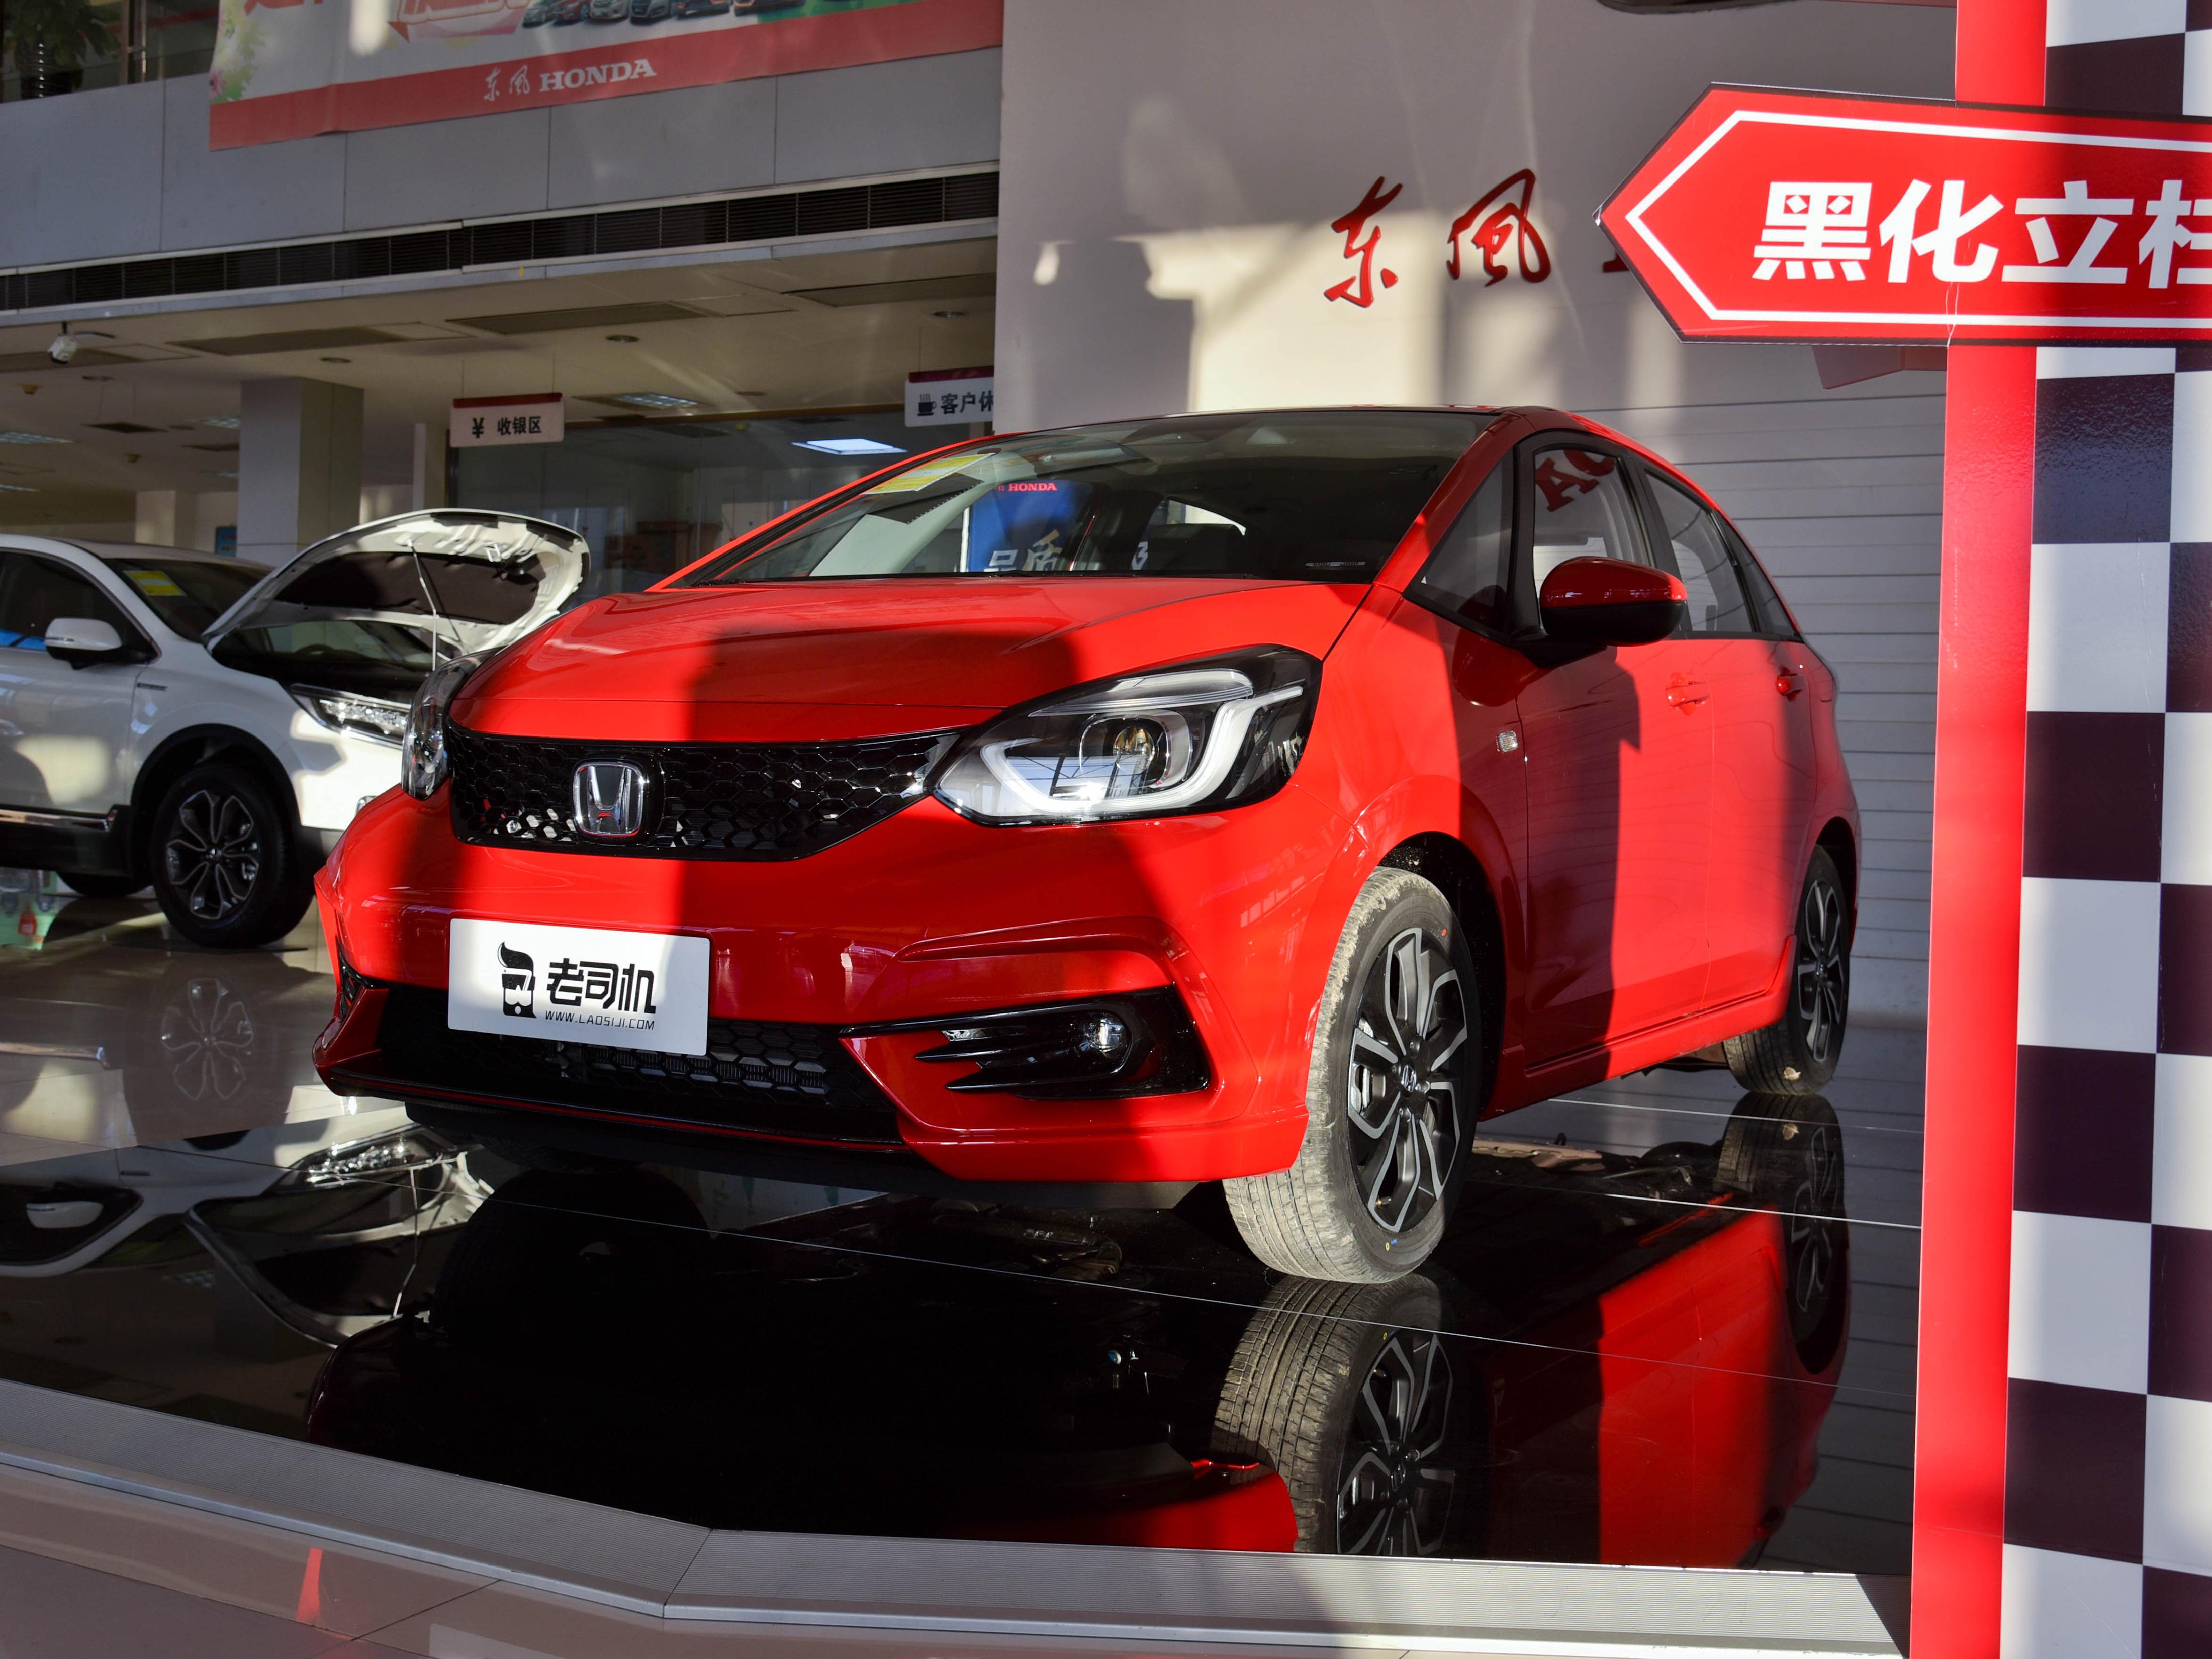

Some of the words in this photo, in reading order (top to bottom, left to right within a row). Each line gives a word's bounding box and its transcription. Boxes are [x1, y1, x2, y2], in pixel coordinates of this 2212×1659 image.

[539, 59, 657, 93] HONDA
[497, 416, 542, 436] 收银区
[1008, 482, 1057, 492] HONDA
[547, 958, 656, 1014] 老司机
[545, 1010, 655, 1031] WWW.LAOSIJI.COM
